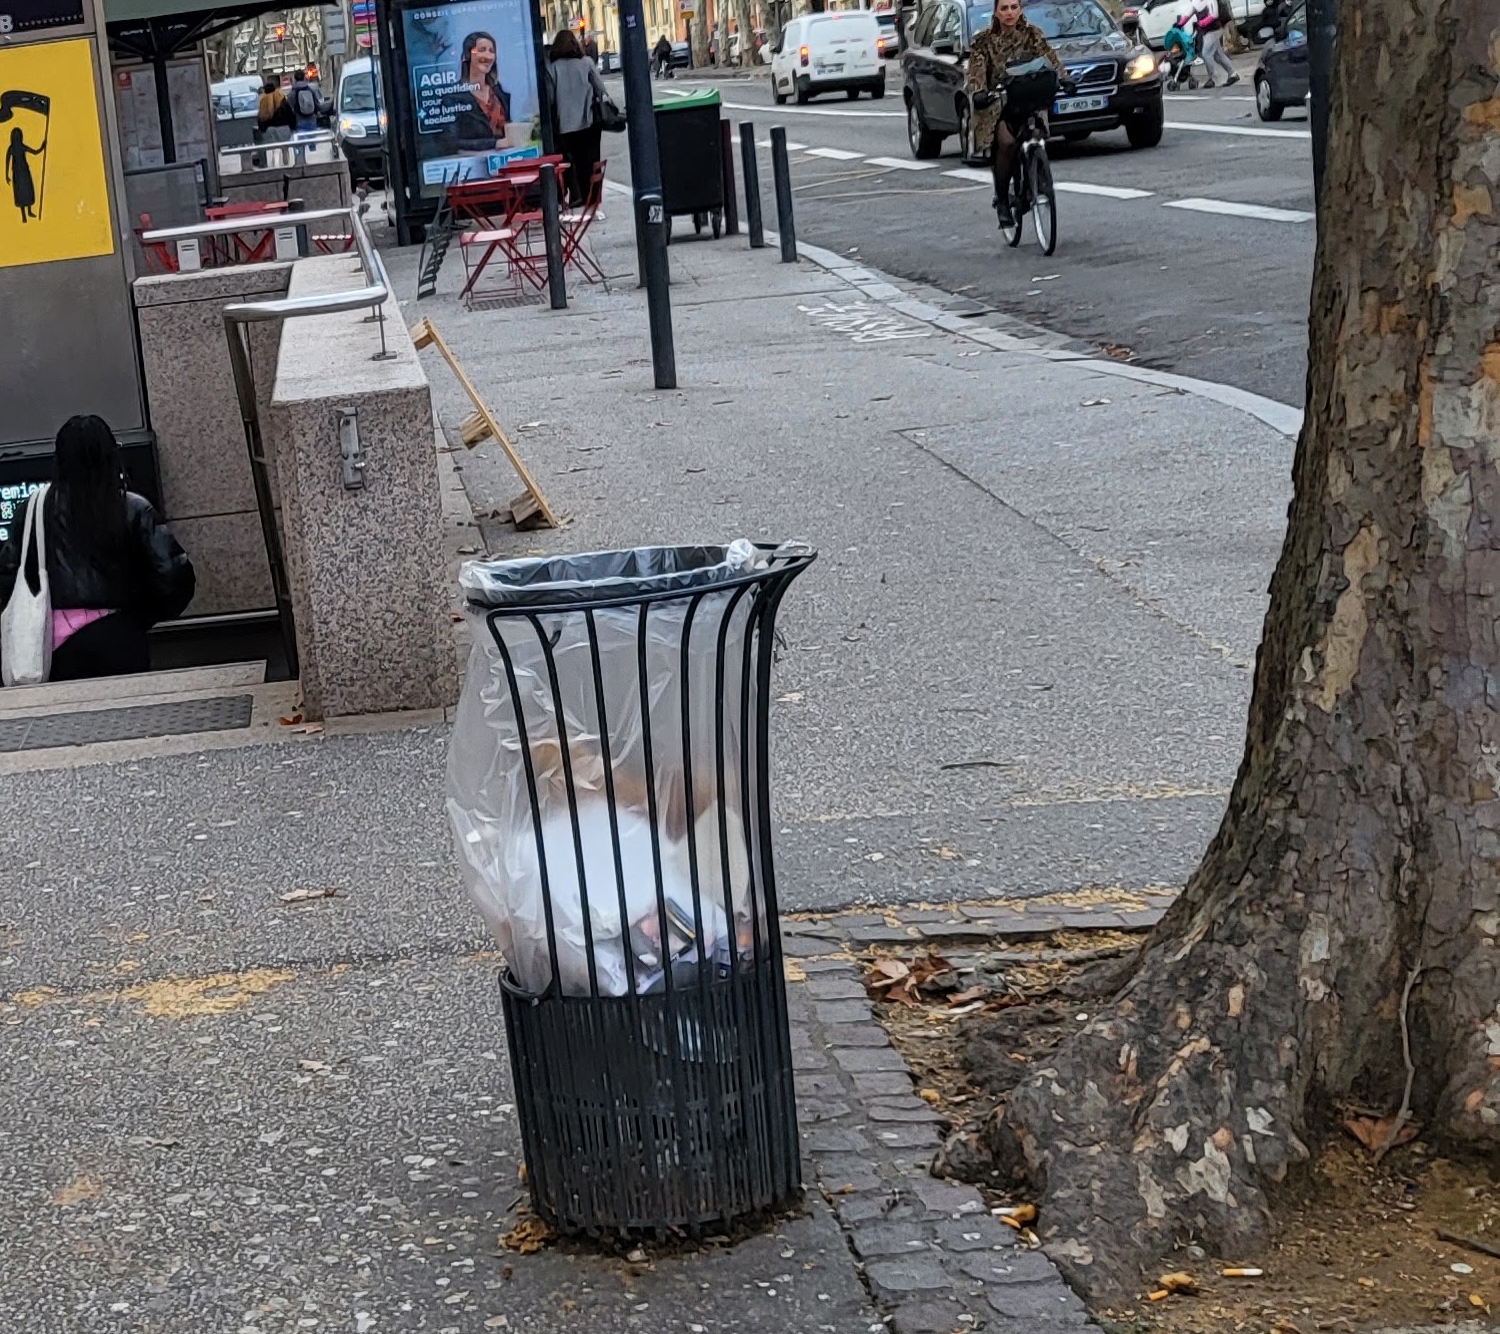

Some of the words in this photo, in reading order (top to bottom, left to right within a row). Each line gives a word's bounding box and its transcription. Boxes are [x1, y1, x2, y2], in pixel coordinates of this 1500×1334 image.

[420, 70, 457, 87] AGIR
[421, 88, 433, 97] au
[434, 82, 481, 97] quotidien
[421, 98, 443, 108] pour
[428, 106, 441, 116] de
[442, 103, 473, 116] justice
[423, 113, 456, 126] sociale
